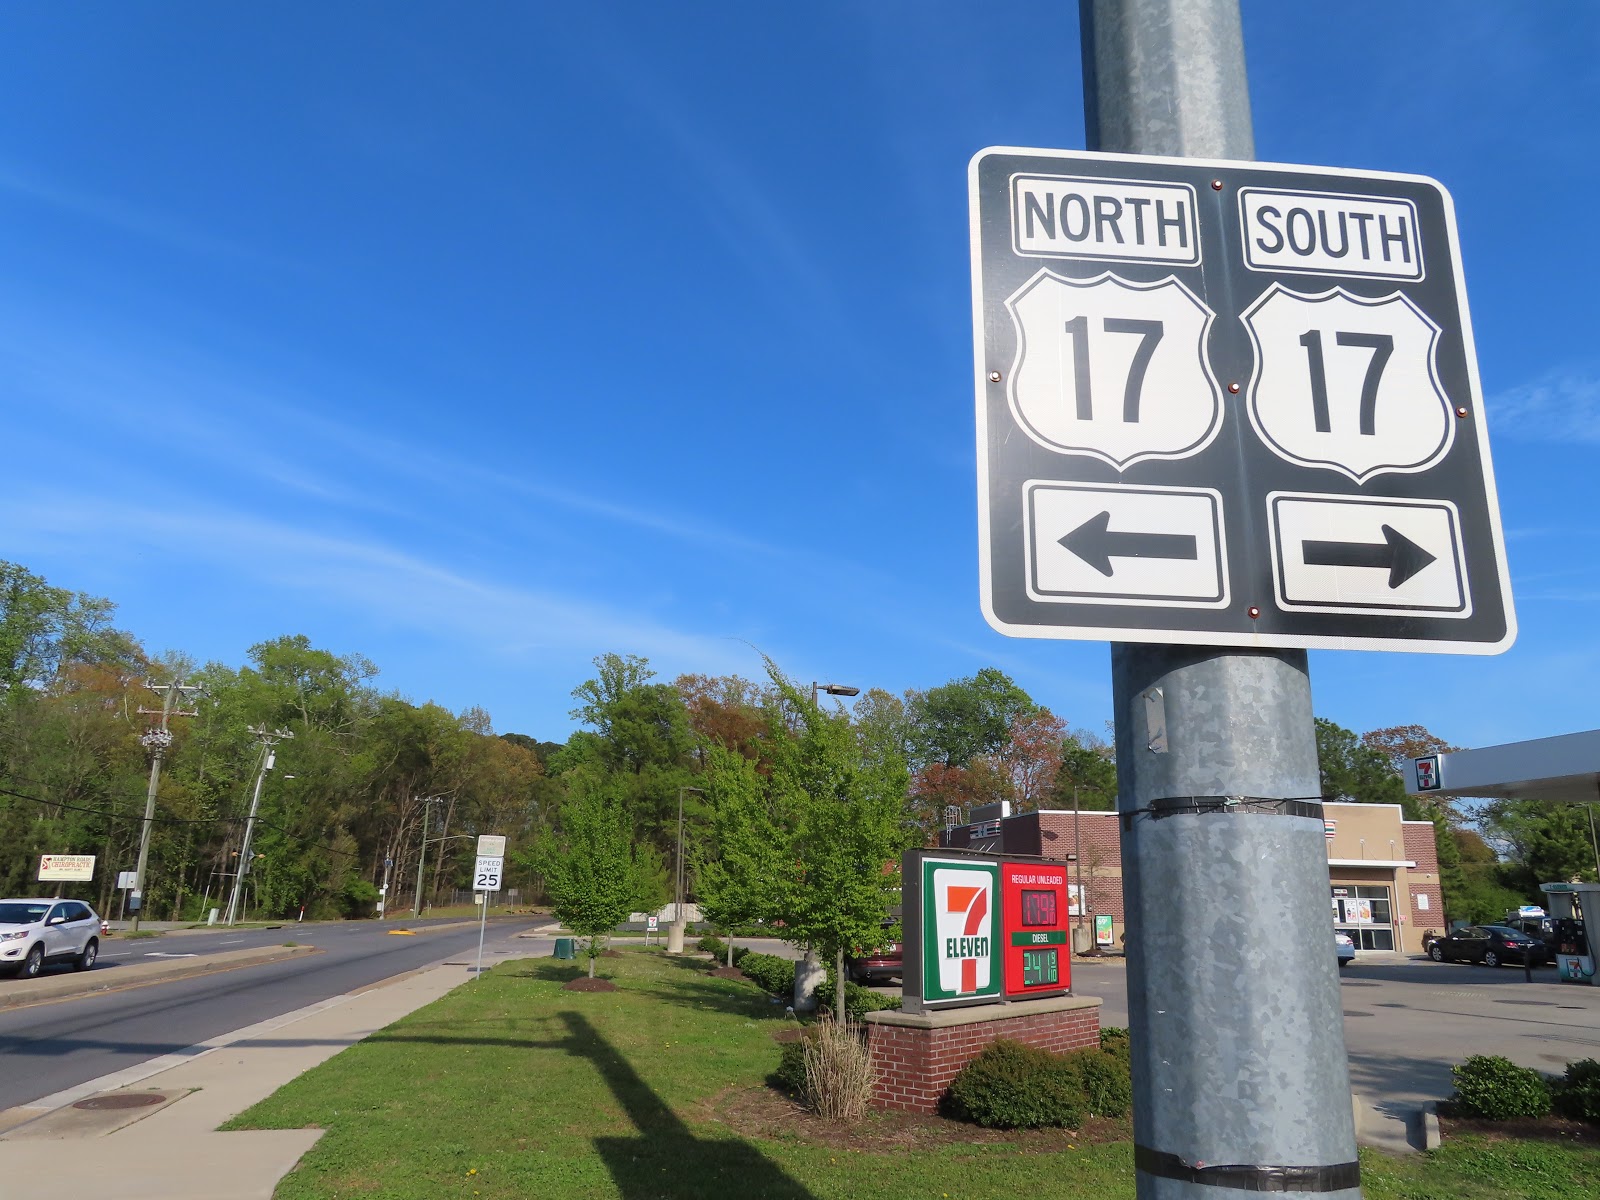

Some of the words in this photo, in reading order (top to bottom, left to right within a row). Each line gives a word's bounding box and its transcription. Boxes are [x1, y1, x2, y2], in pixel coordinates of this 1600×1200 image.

[1024, 191, 1189, 248] NORTH
[1256, 205, 1411, 264] SOUTH
[1065, 315, 1164, 424] 17
[1299, 329, 1394, 436] 17
[477, 874, 498, 886] 25
[1012, 874, 1036, 884] REGULAR
[1037, 875, 1063, 885] UNLEADED
[1032, 933, 1049, 943] DIESEL
